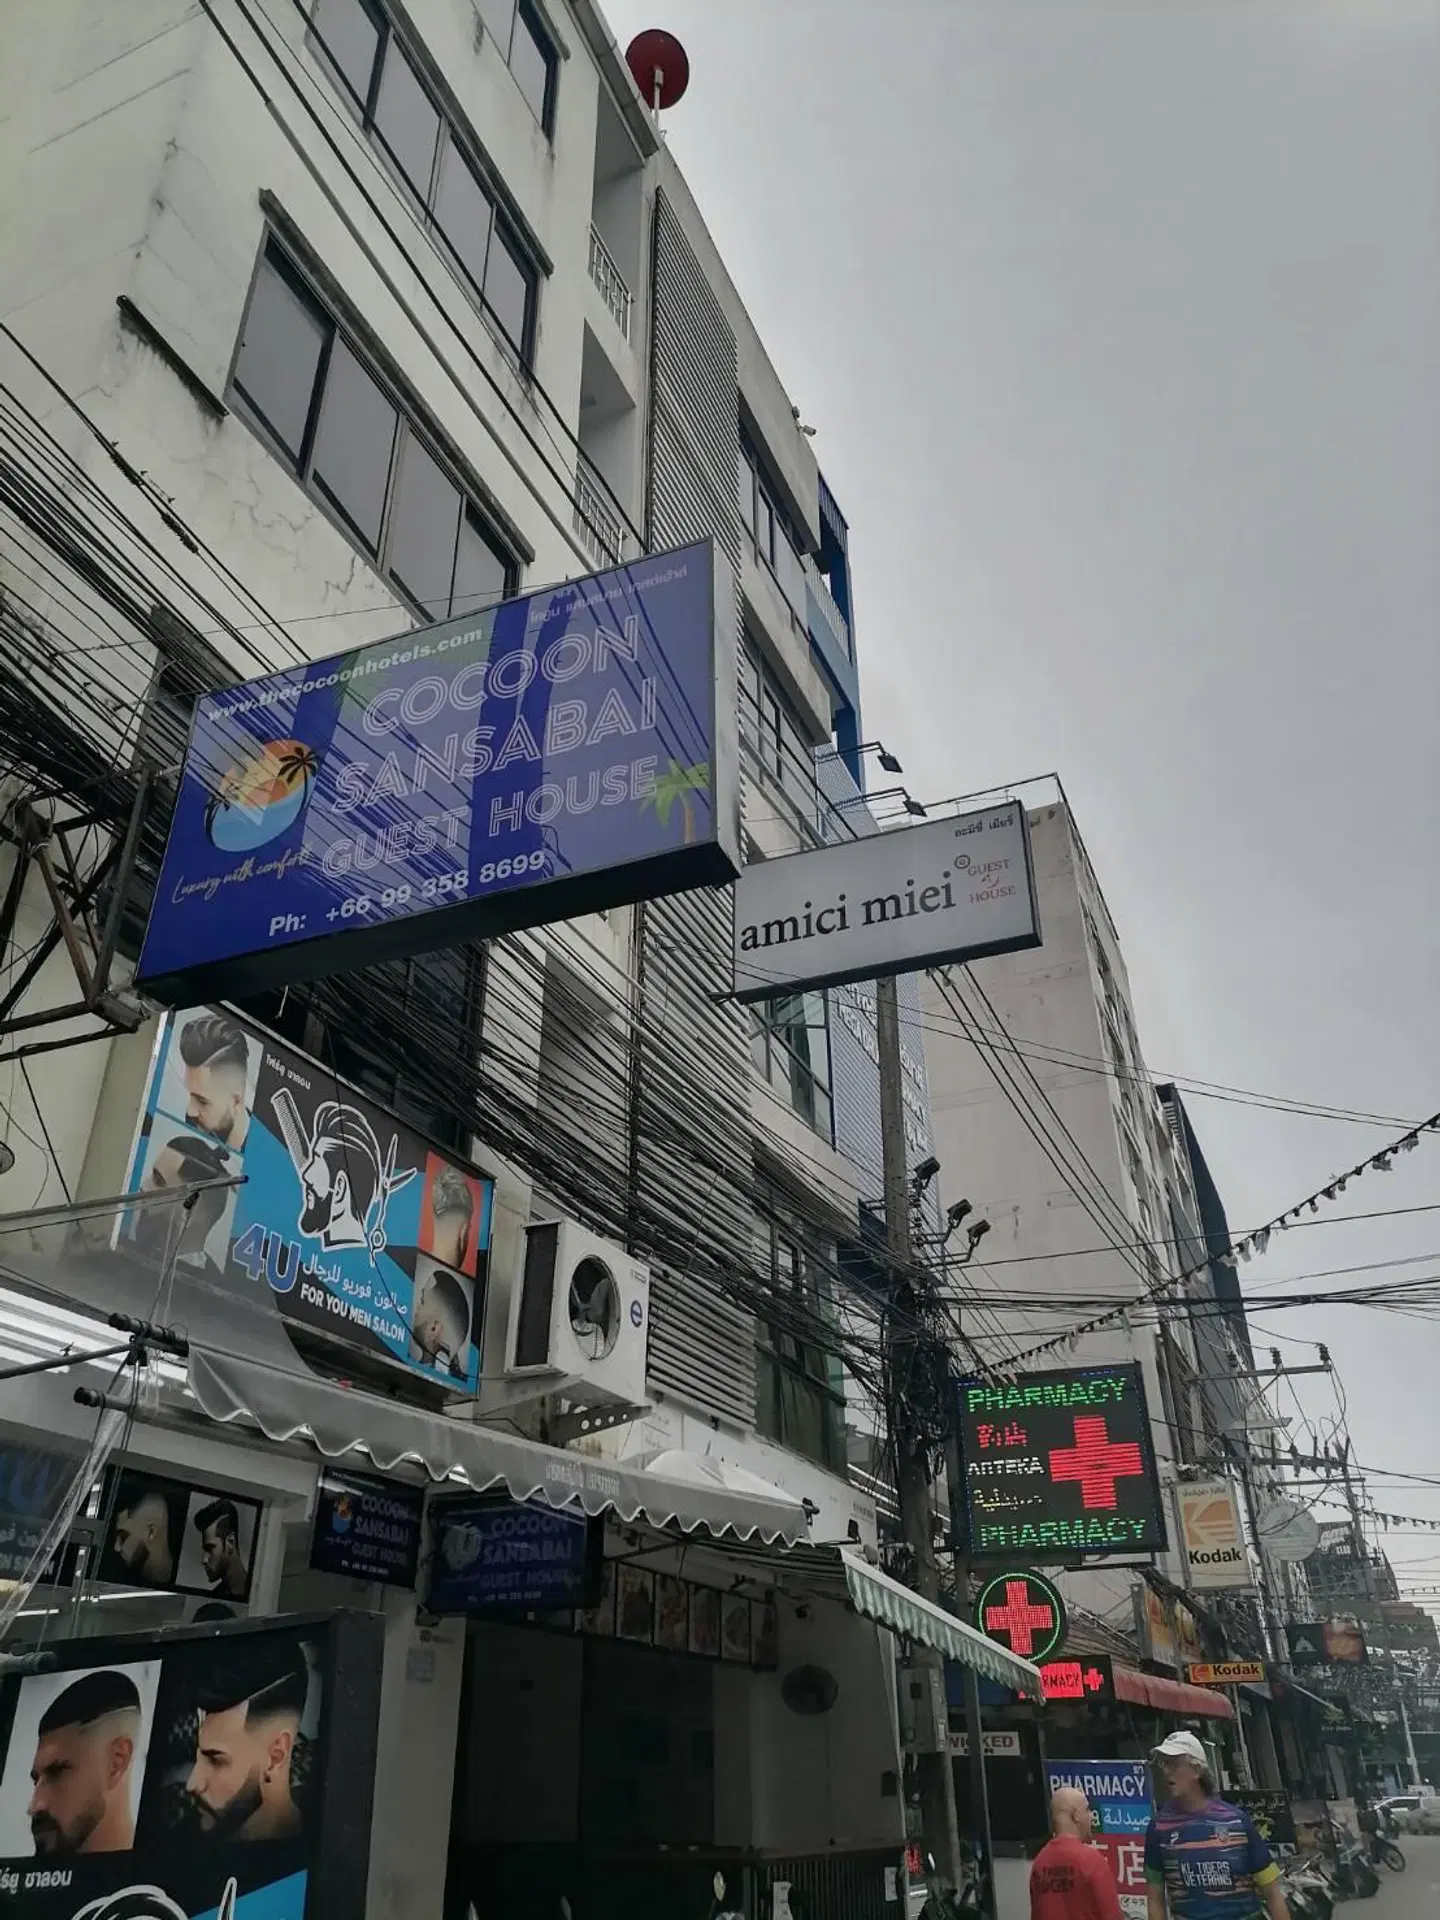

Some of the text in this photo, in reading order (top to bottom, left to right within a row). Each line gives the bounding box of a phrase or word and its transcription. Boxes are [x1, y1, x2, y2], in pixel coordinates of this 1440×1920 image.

[207, 628, 482, 722] www.thecocoonhotels.com
[362, 615, 638, 737] COCOON
[332, 677, 657, 813] SANSABAI
[322, 756, 658, 879] GUEST HOUSE
[967, 859, 1011, 876] GUEST
[268, 850, 546, 937] Ph: +66 99 358 8699
[740, 871, 956, 952] amici miei
[969, 885, 1016, 905] HOUSE
[232, 1223, 301, 1294] 4U
[300, 1282, 407, 1343] FOR YOU MEN SALON
[967, 1377, 1128, 1413] PHARMACY
[980, 1517, 1147, 1547] PHARMACY
[1188, 1547, 1243, 1565] Kodak
[1042, 1672, 1079, 1688] RMACY
[1213, 1663, 1260, 1677] Kodak
[1049, 1774, 1146, 1798] PHARMACY
[1180, 1860, 1231, 1875] KL TIGERS
